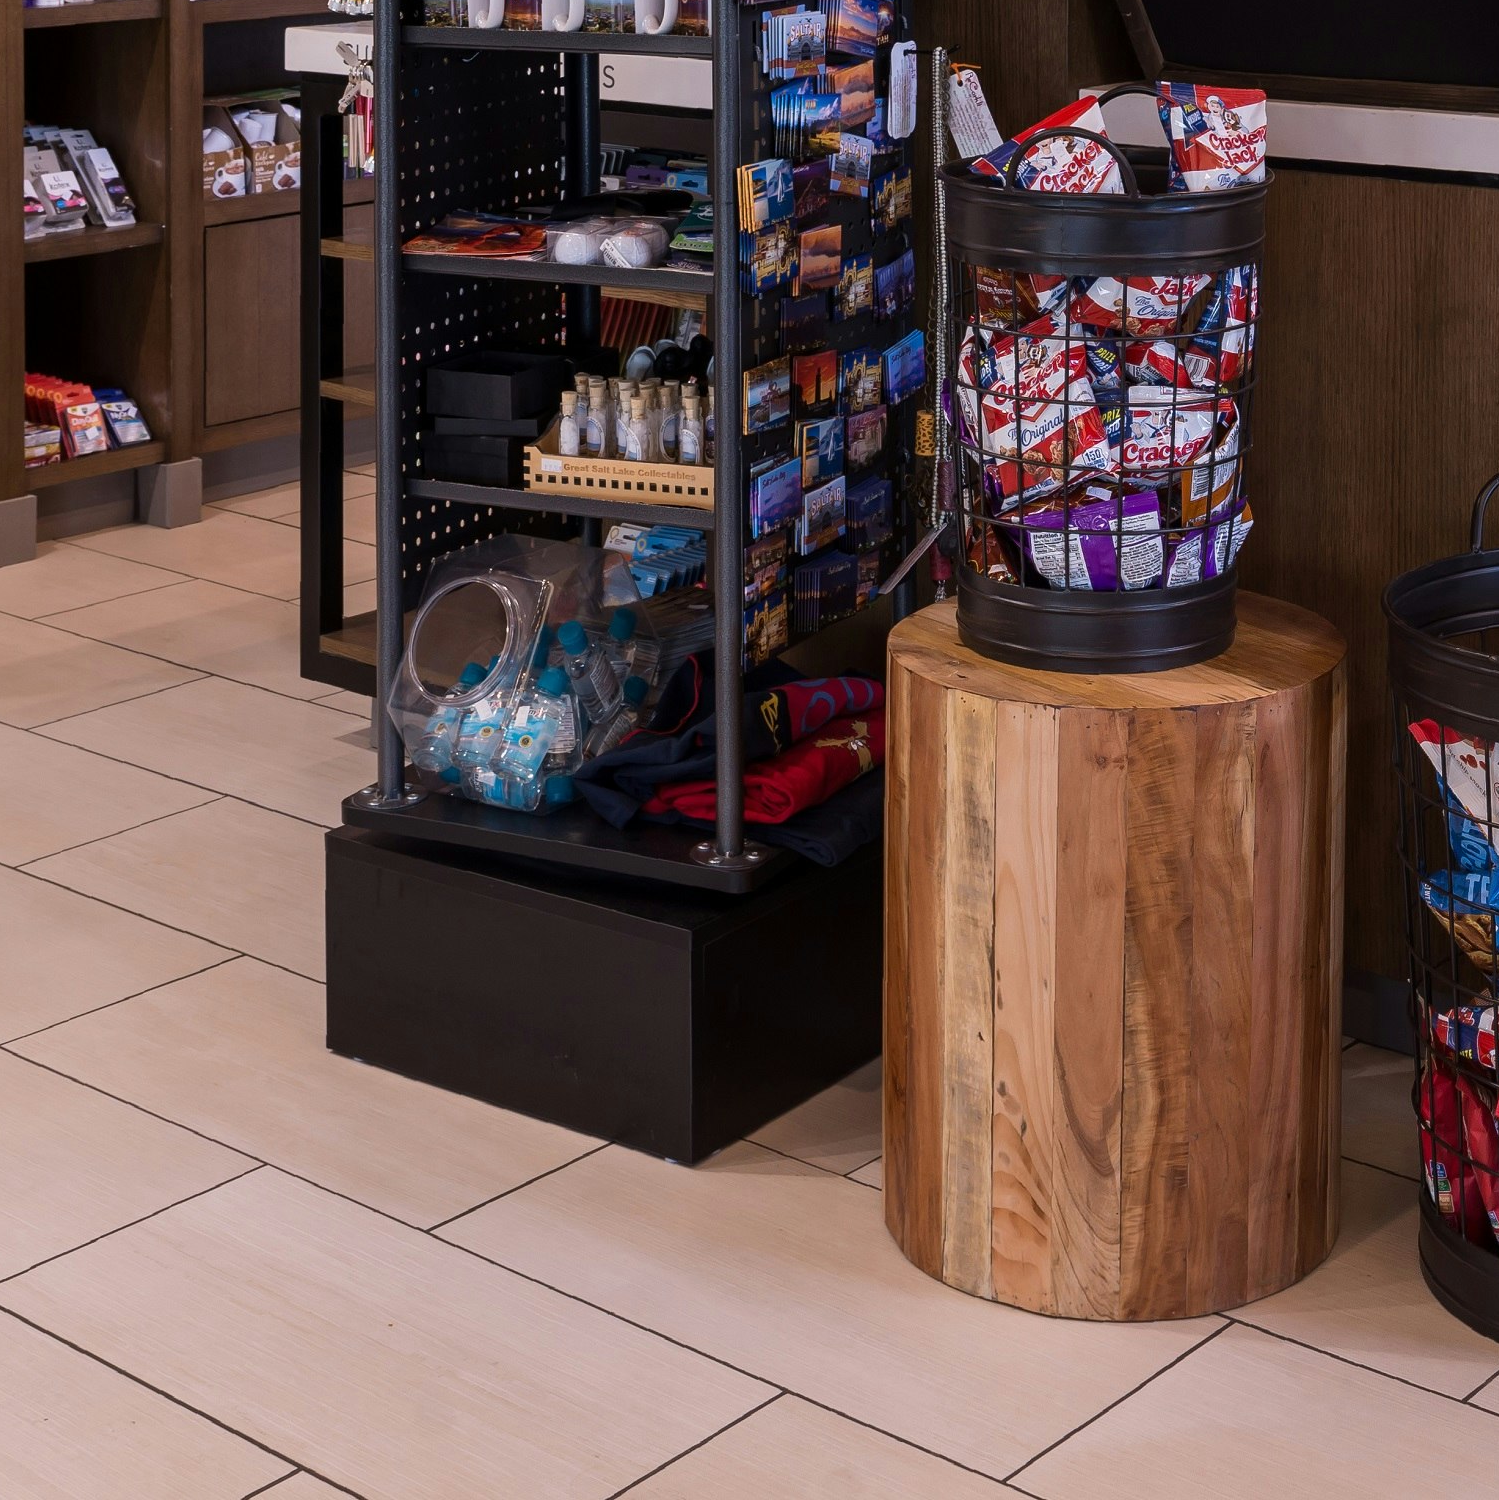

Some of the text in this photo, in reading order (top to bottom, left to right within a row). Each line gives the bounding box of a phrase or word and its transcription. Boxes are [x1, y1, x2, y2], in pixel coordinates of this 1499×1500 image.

[790, 23, 822, 42] SALTAIR
[1208, 126, 1267, 151] Cracker
[1222, 145, 1258, 169] Jack
[1134, 295, 1151, 306] The
[1096, 346, 1117, 364] PRIZE
[1102, 407, 1122, 423] PRIZ
[1021, 408, 1065, 448] Original
[1084, 449, 1101, 463] 150
[564, 463, 696, 482] Great Salt Lake Collectables
